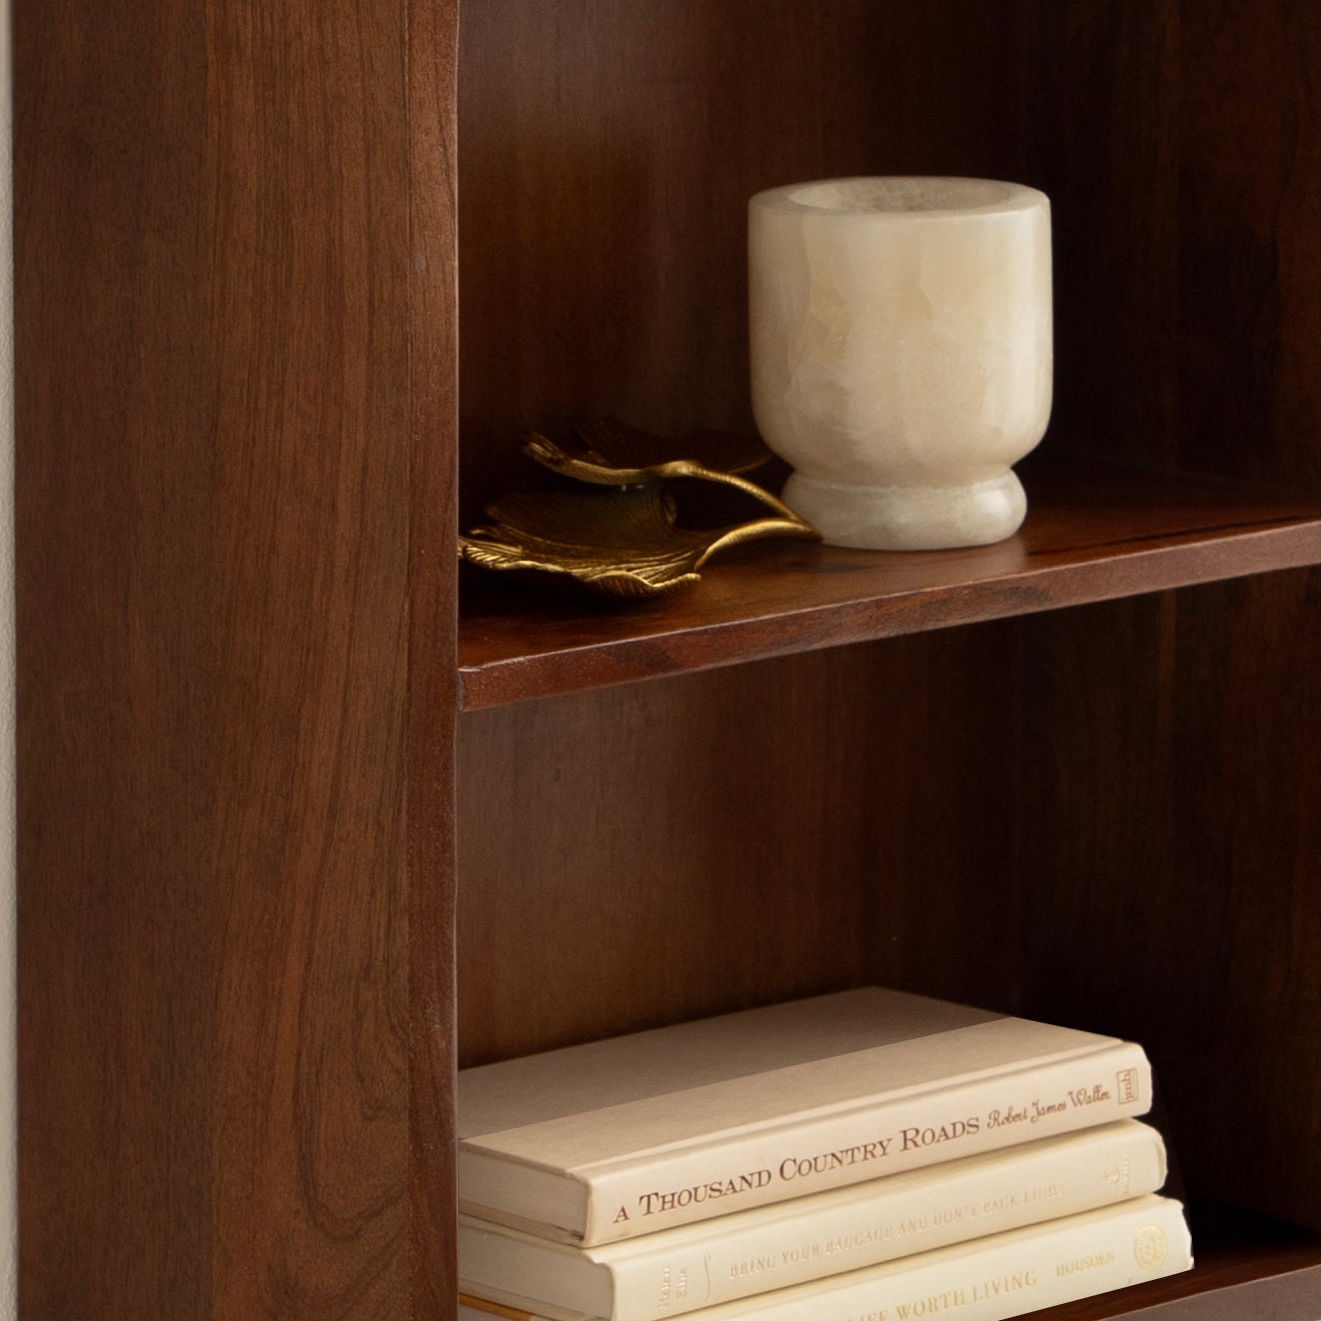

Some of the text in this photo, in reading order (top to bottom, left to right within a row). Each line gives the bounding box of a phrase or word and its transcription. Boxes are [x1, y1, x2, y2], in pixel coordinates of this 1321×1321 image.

[986, 1084, 1111, 1129] Robert James Waller
[613, 1117, 981, 1224] A THOUSAND COUNTRY ROADS
[730, 1254, 776, 1279] BRING
[781, 1244, 820, 1266] YOUR
[896, 1216, 928, 1236] AND
[933, 1204, 978, 1227] DON'T
[1055, 1249, 1116, 1278] HOUSDEN
[895, 1289, 966, 1321] WORTH
[971, 1270, 1038, 1303] LIVING
